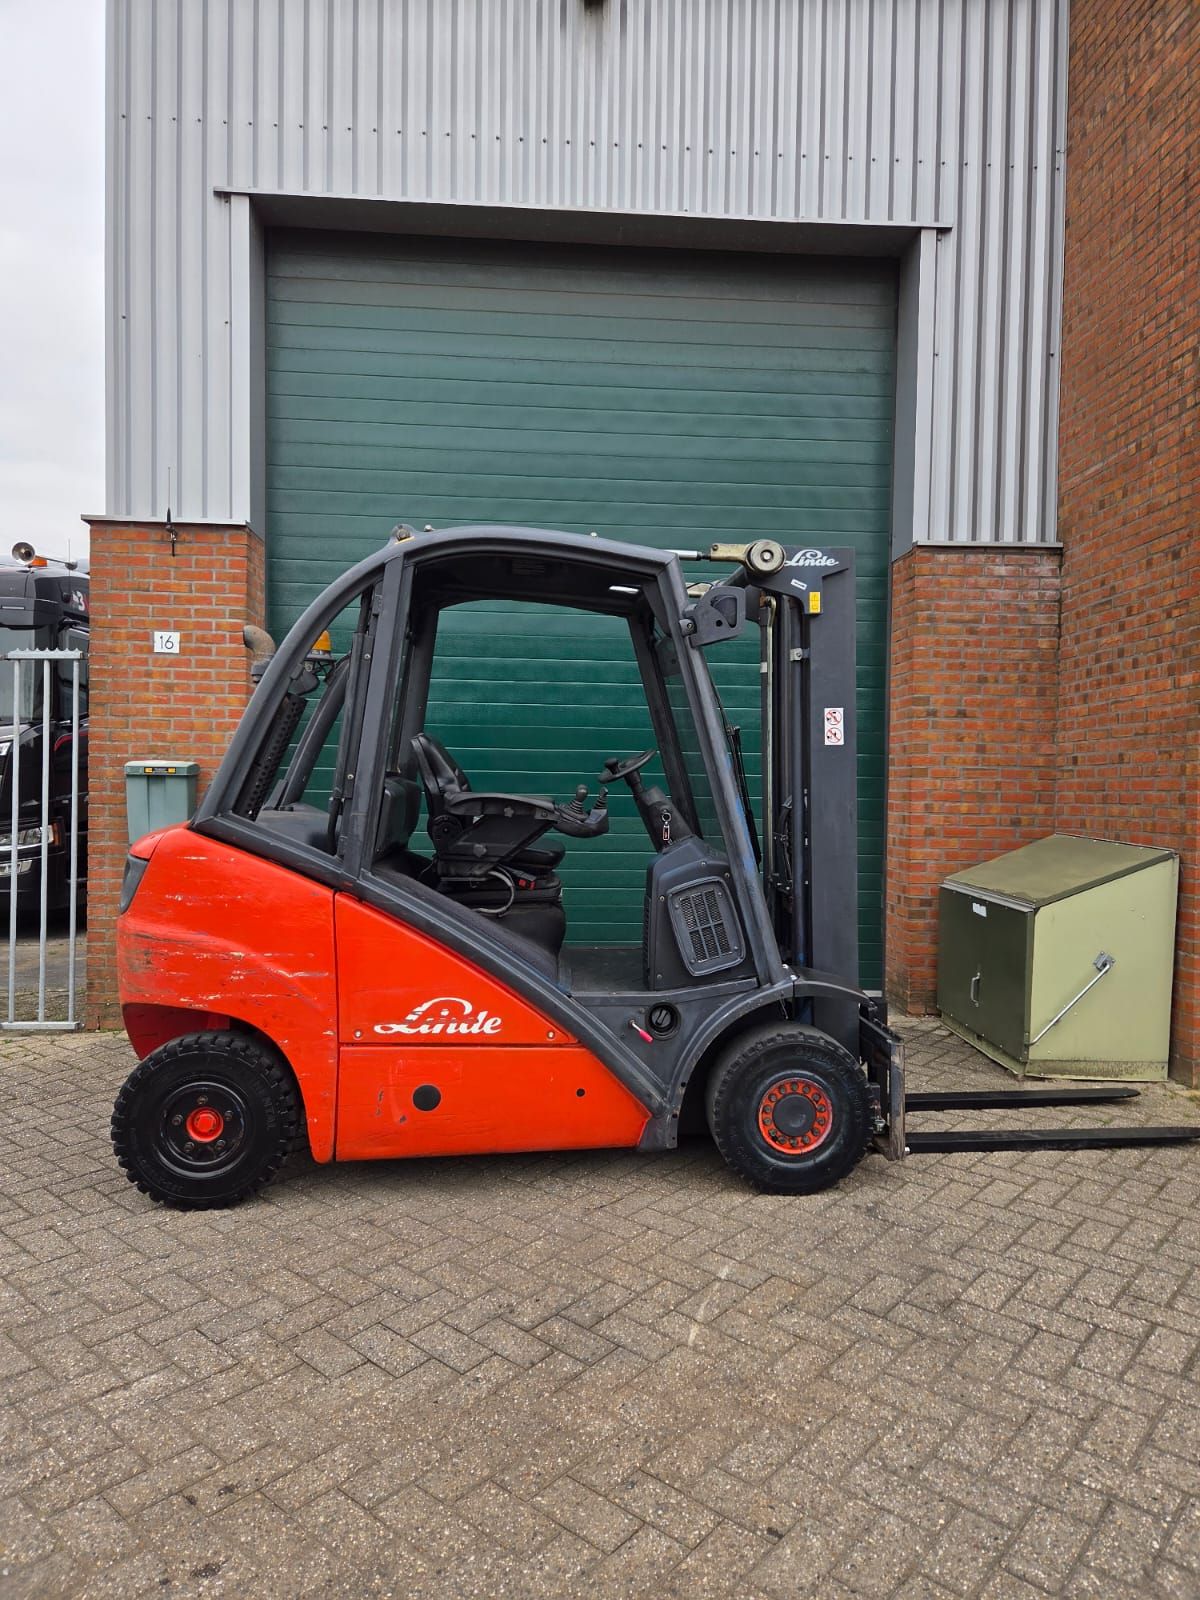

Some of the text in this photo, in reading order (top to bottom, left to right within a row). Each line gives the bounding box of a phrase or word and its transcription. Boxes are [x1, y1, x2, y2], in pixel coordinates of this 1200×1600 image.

[783, 549, 839, 566] Linde
[160, 635, 174, 650] 16
[374, 997, 502, 1034] Linde
